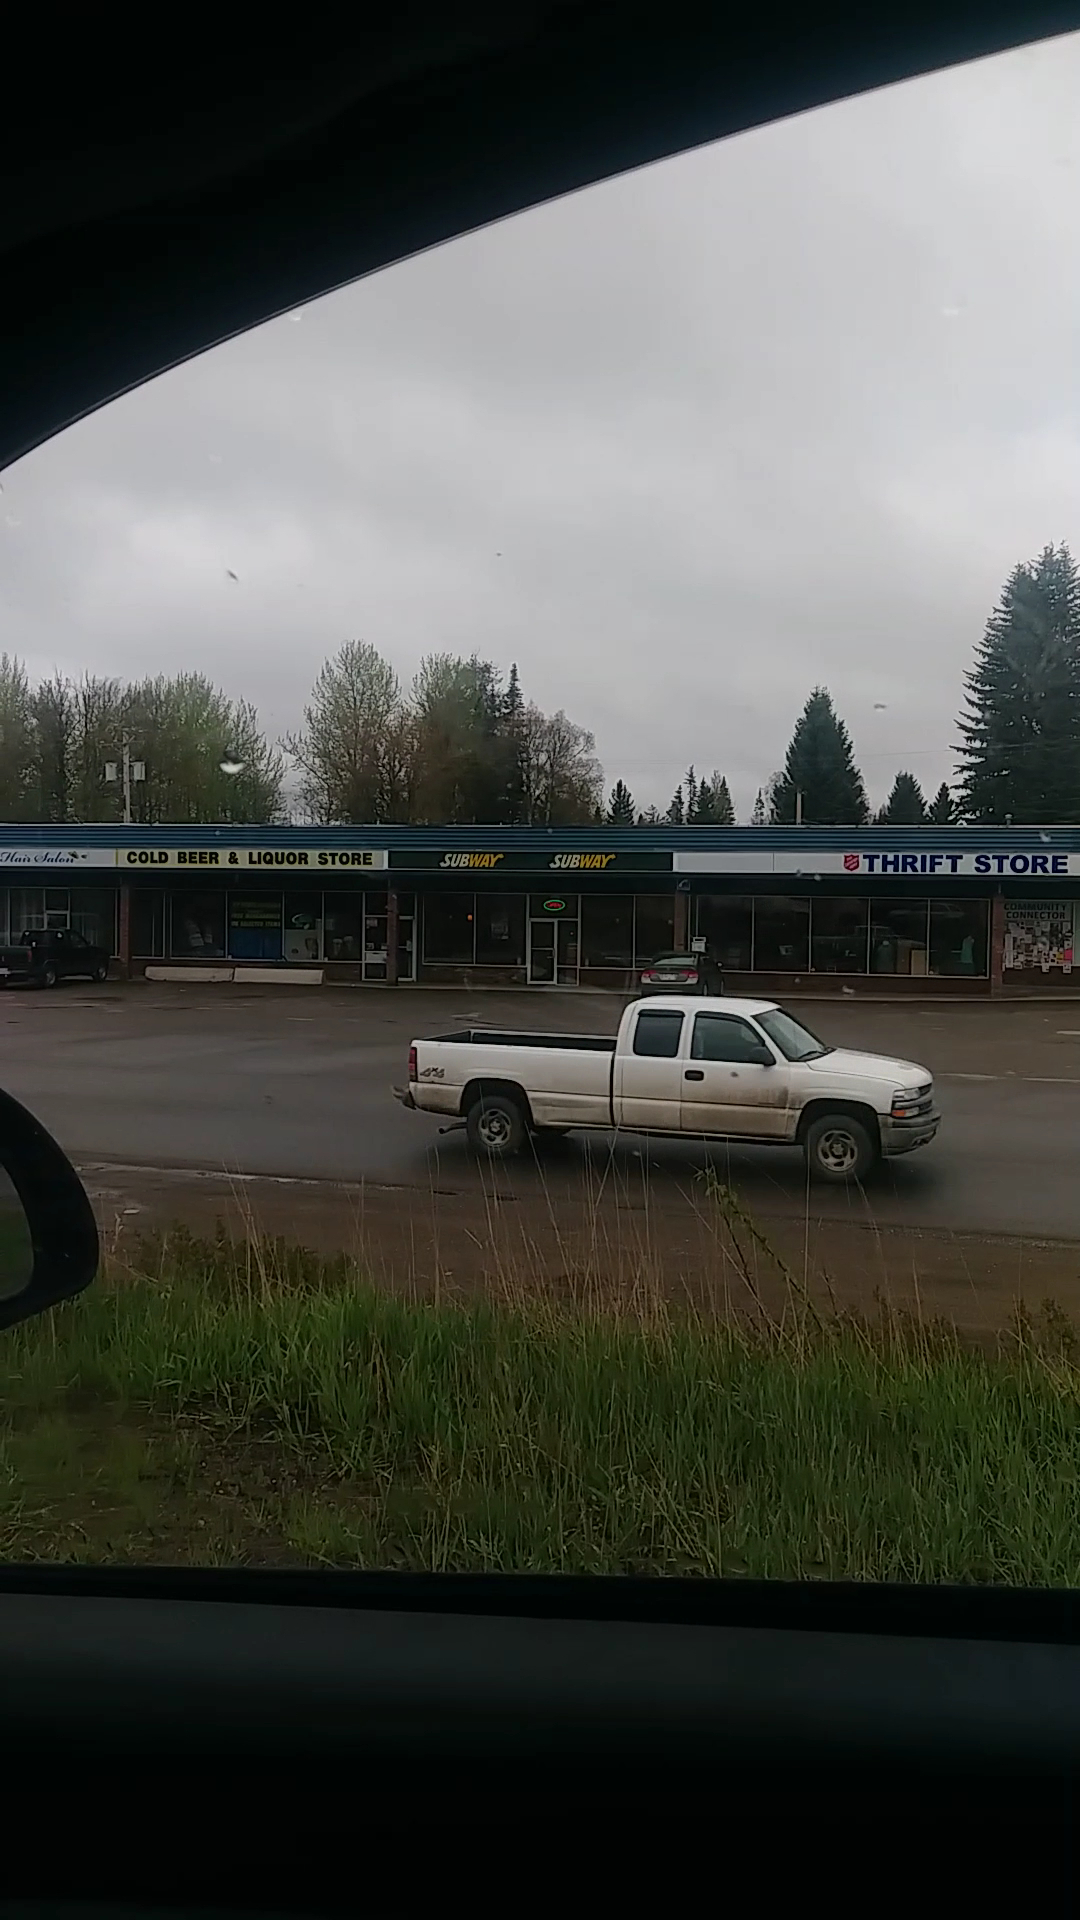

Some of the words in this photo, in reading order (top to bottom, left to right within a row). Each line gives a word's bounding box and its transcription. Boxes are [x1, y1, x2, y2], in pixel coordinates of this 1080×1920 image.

[0, 851, 31, 863] Hair
[33, 851, 74, 863] Salon
[127, 851, 169, 864] COLD
[177, 852, 219, 865] BEER
[228, 852, 239, 865] &
[248, 852, 309, 866] LIQUOR
[318, 853, 373, 866] STORE
[439, 853, 504, 868] SUBWAY
[549, 854, 616, 869] SUBWAY
[863, 854, 963, 873] THRIFT
[974, 855, 1069, 874] STORE
[1003, 902, 1066, 911] COMMUNITY
[1006, 911, 1066, 920] CONNECTOR
